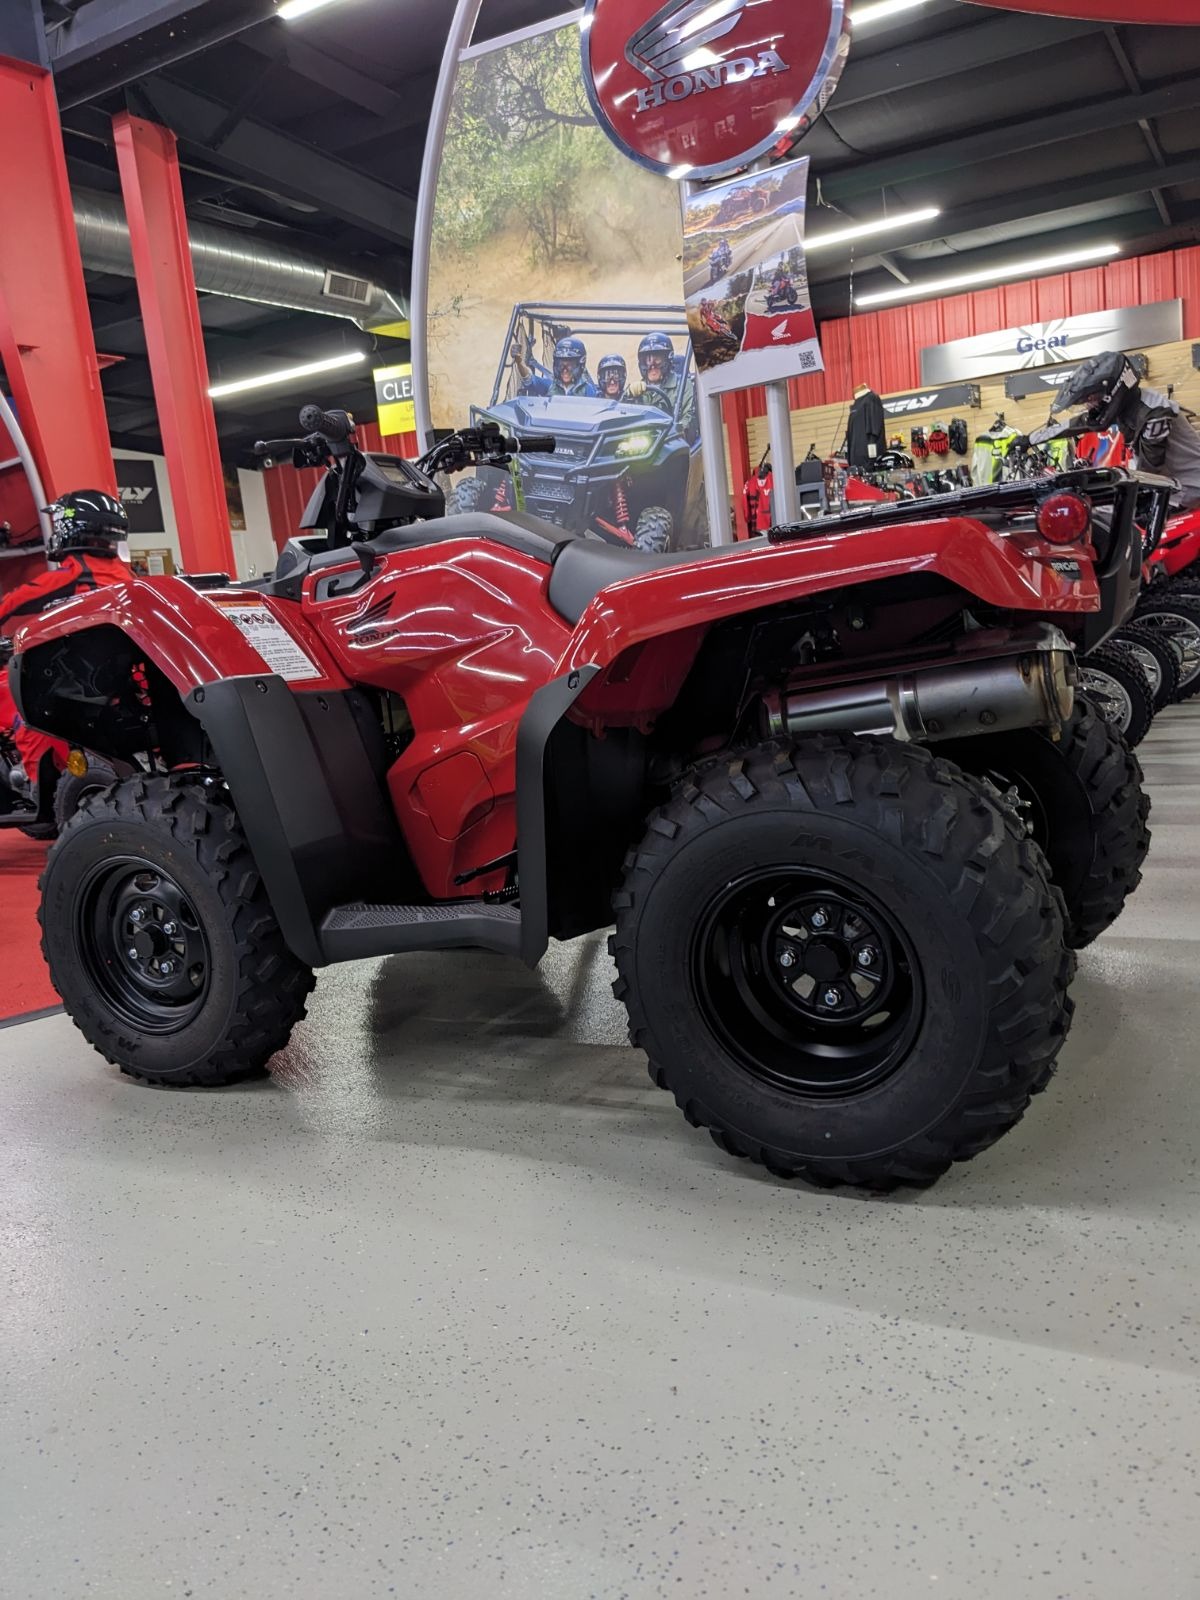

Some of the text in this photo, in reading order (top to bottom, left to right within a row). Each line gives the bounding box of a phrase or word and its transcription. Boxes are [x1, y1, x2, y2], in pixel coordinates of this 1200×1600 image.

[634, 49, 790, 113] HONDA
[1016, 333, 1069, 354] Gear
[382, 380, 414, 400] CLE
[883, 394, 939, 414] FLY
[348, 629, 401, 646] HONDA
